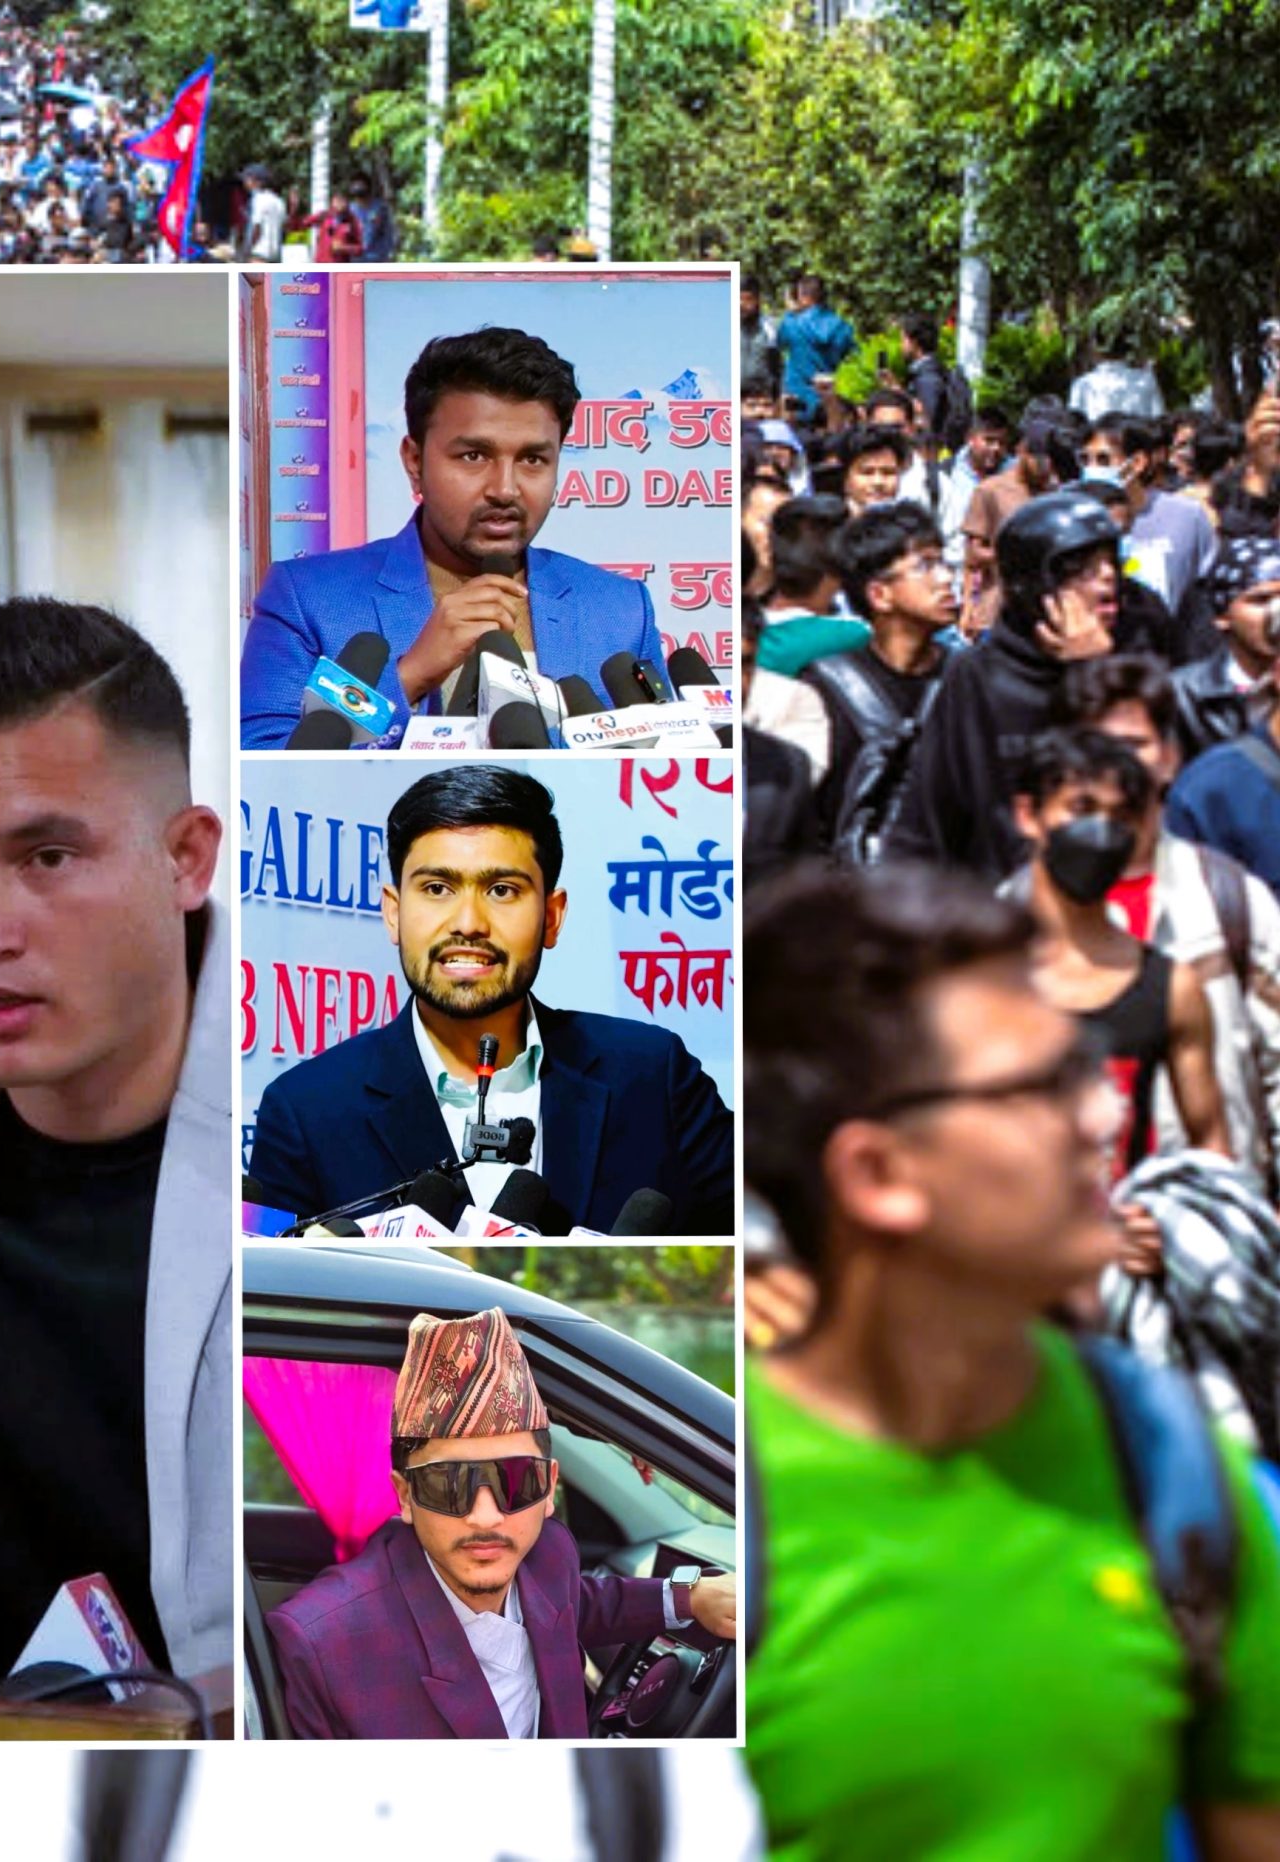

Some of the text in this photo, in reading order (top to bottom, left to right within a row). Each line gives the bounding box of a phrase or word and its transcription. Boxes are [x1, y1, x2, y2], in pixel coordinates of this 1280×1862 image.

[557, 469, 628, 504] AD
[240, 799, 384, 914] GALLE
[607, 835, 733, 920] मोर्ड
[271, 962, 401, 1056] NEPA
[618, 931, 732, 1016] फोन
